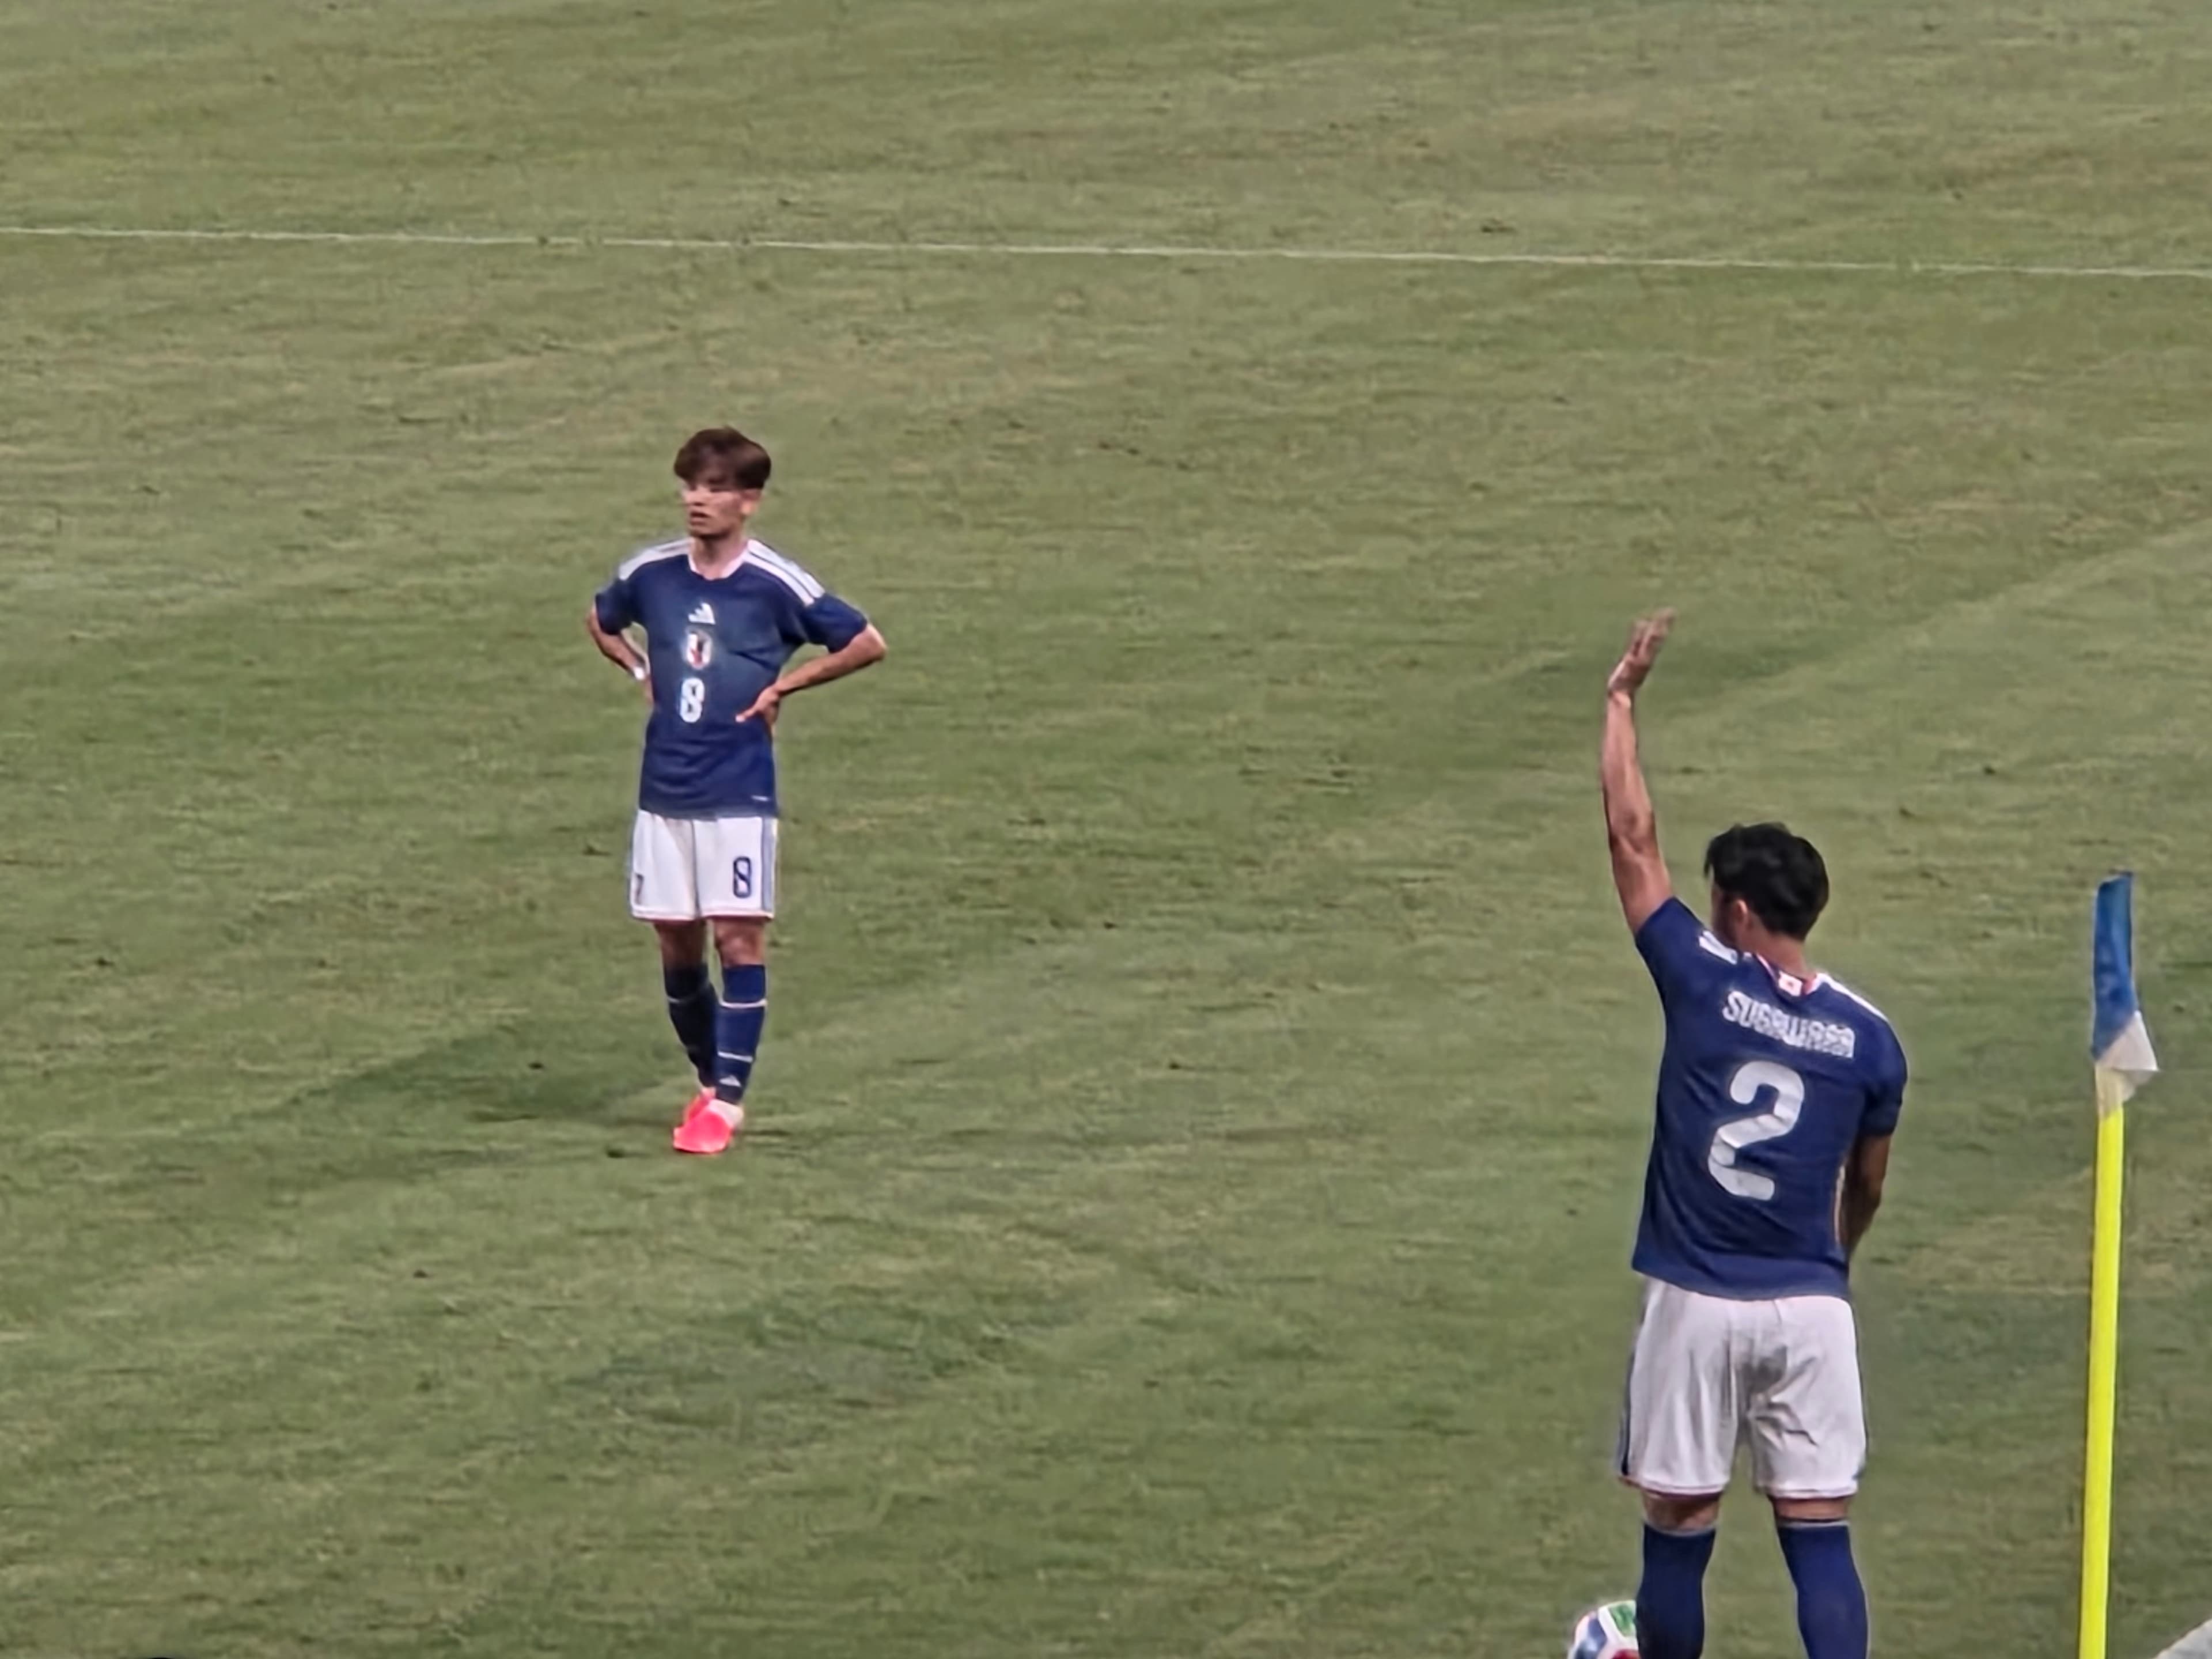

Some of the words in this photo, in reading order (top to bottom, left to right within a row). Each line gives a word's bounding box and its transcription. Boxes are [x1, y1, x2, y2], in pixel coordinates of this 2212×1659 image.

[680, 677, 705, 723] 8
[733, 856, 752, 899] 8
[1707, 1060, 1805, 1200] 2
